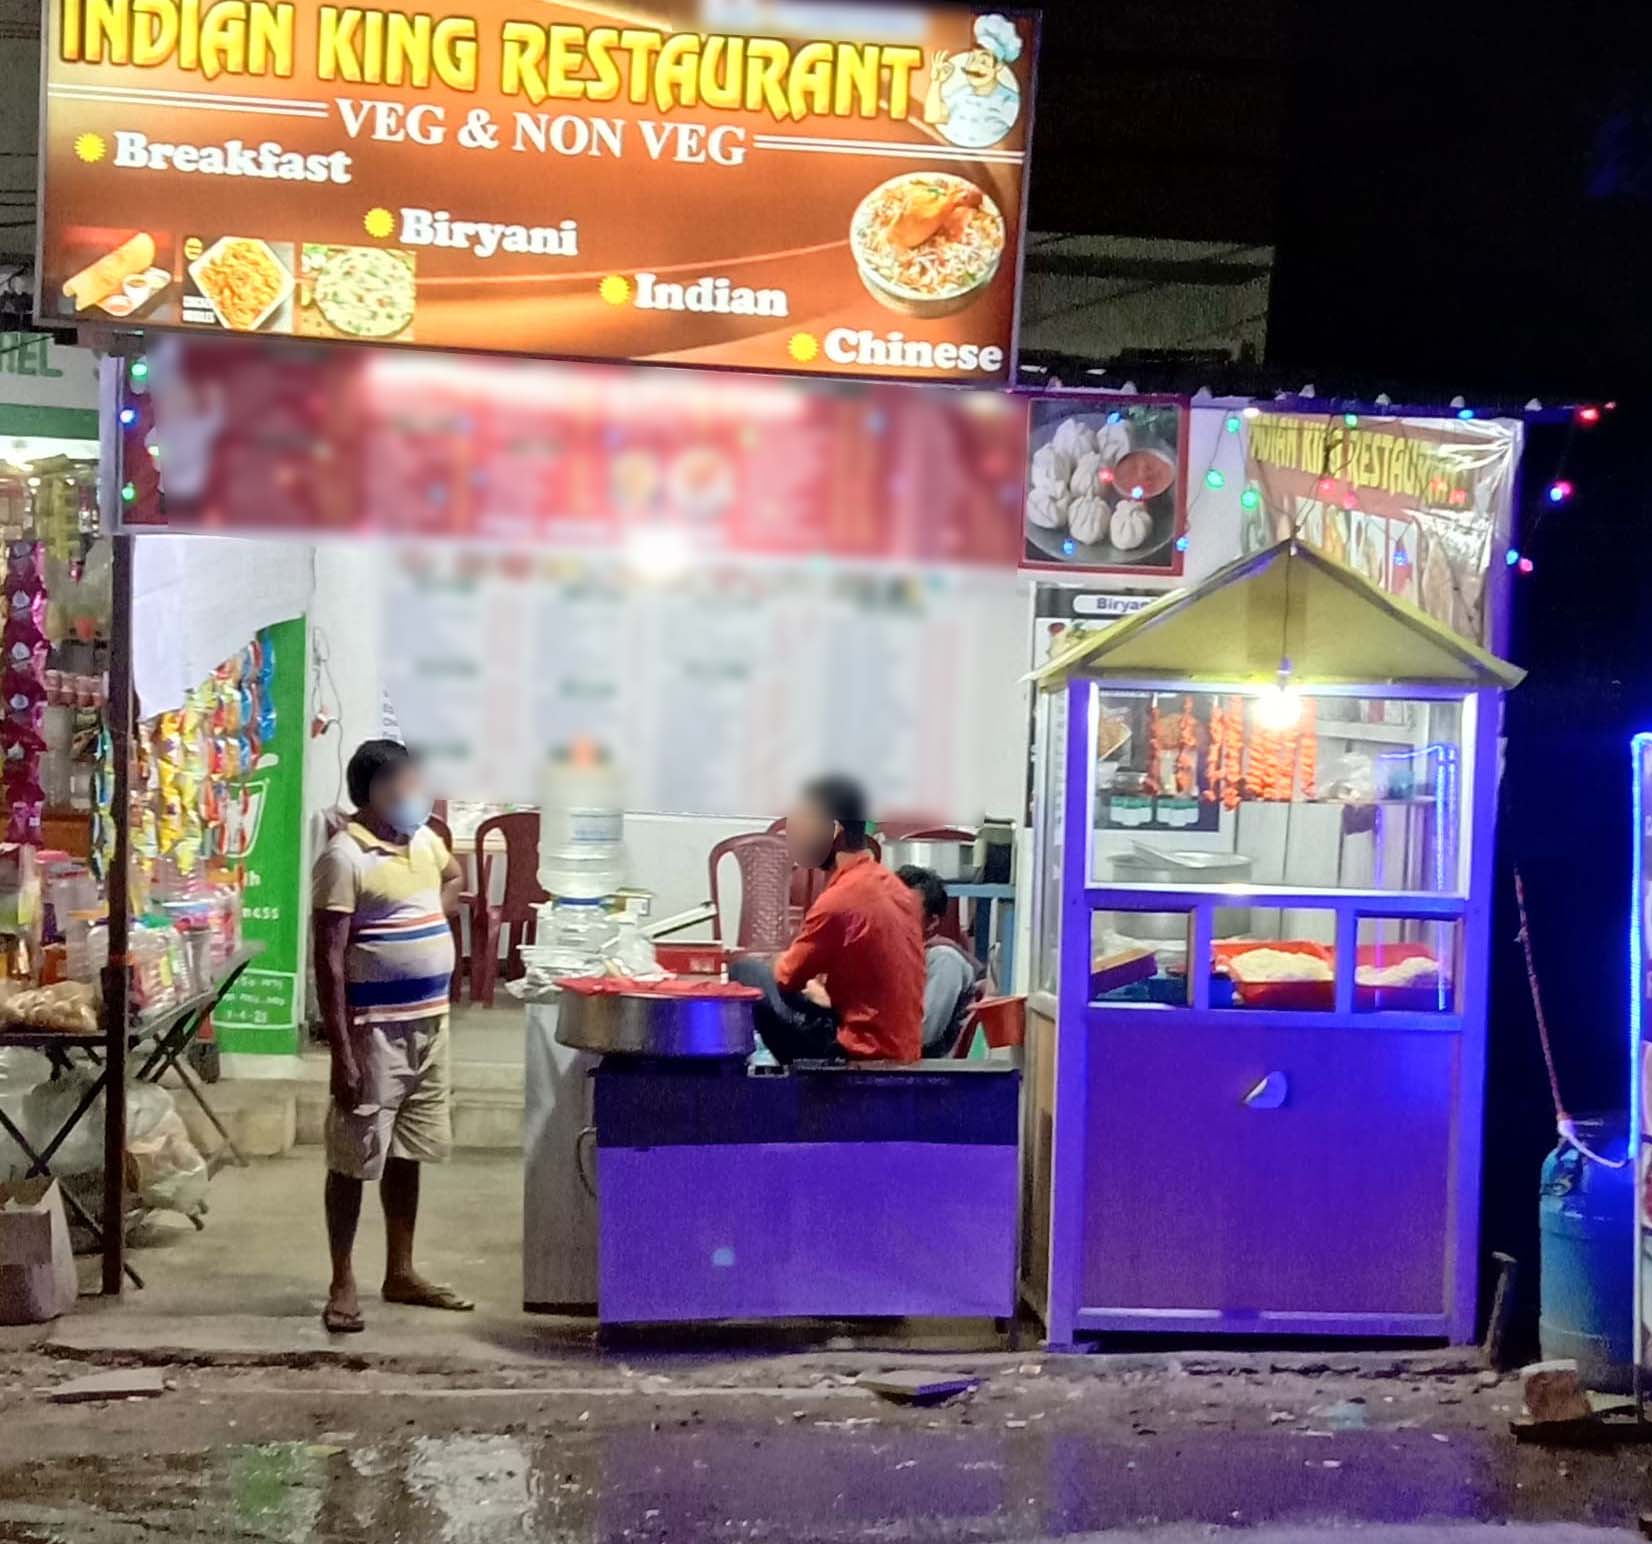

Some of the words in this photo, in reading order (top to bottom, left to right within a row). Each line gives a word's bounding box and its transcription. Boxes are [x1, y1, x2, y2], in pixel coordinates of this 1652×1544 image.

[61, 0, 295, 80] INDIAN
[316, 5, 478, 91] KING
[500, 21, 922, 122] RESTAURANT
[113, 131, 353, 184] Breakfast
[335, 99, 445, 144] VEG
[458, 109, 499, 149] &
[513, 112, 625, 158] NON
[638, 120, 747, 166] VEG
[400, 207, 579, 258] Biryani
[634, 272, 789, 318] Indian
[823, 327, 1003, 372] Chinese
